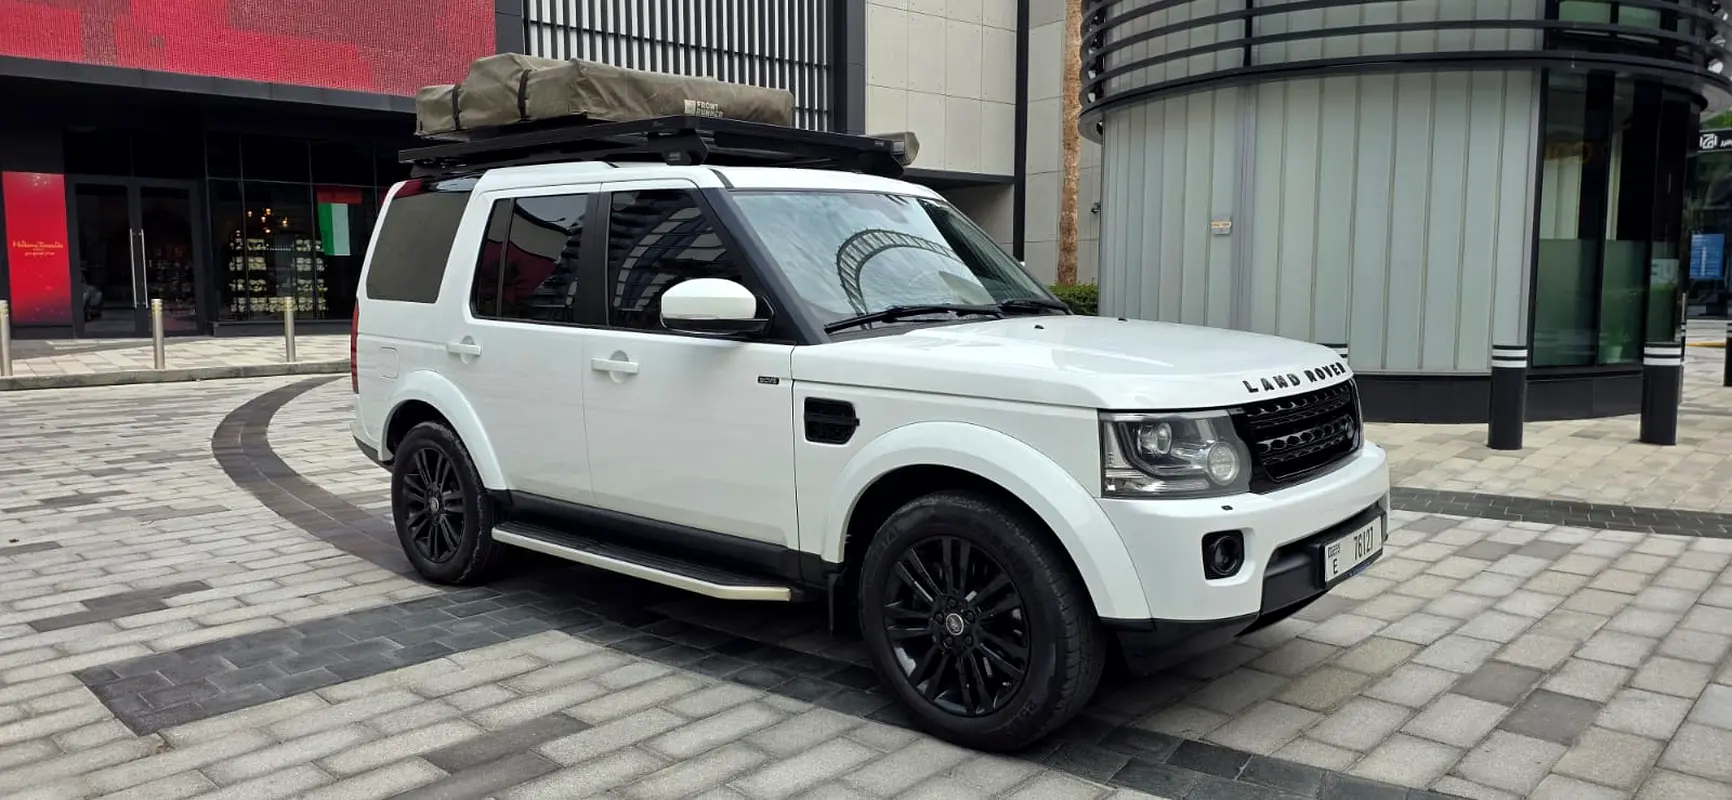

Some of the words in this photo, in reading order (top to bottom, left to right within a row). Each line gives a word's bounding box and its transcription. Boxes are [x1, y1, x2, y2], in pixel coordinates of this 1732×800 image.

[1242, 373, 1300, 393] LAND
[1304, 361, 1346, 382] ROVER
[1332, 557, 1338, 575] E
